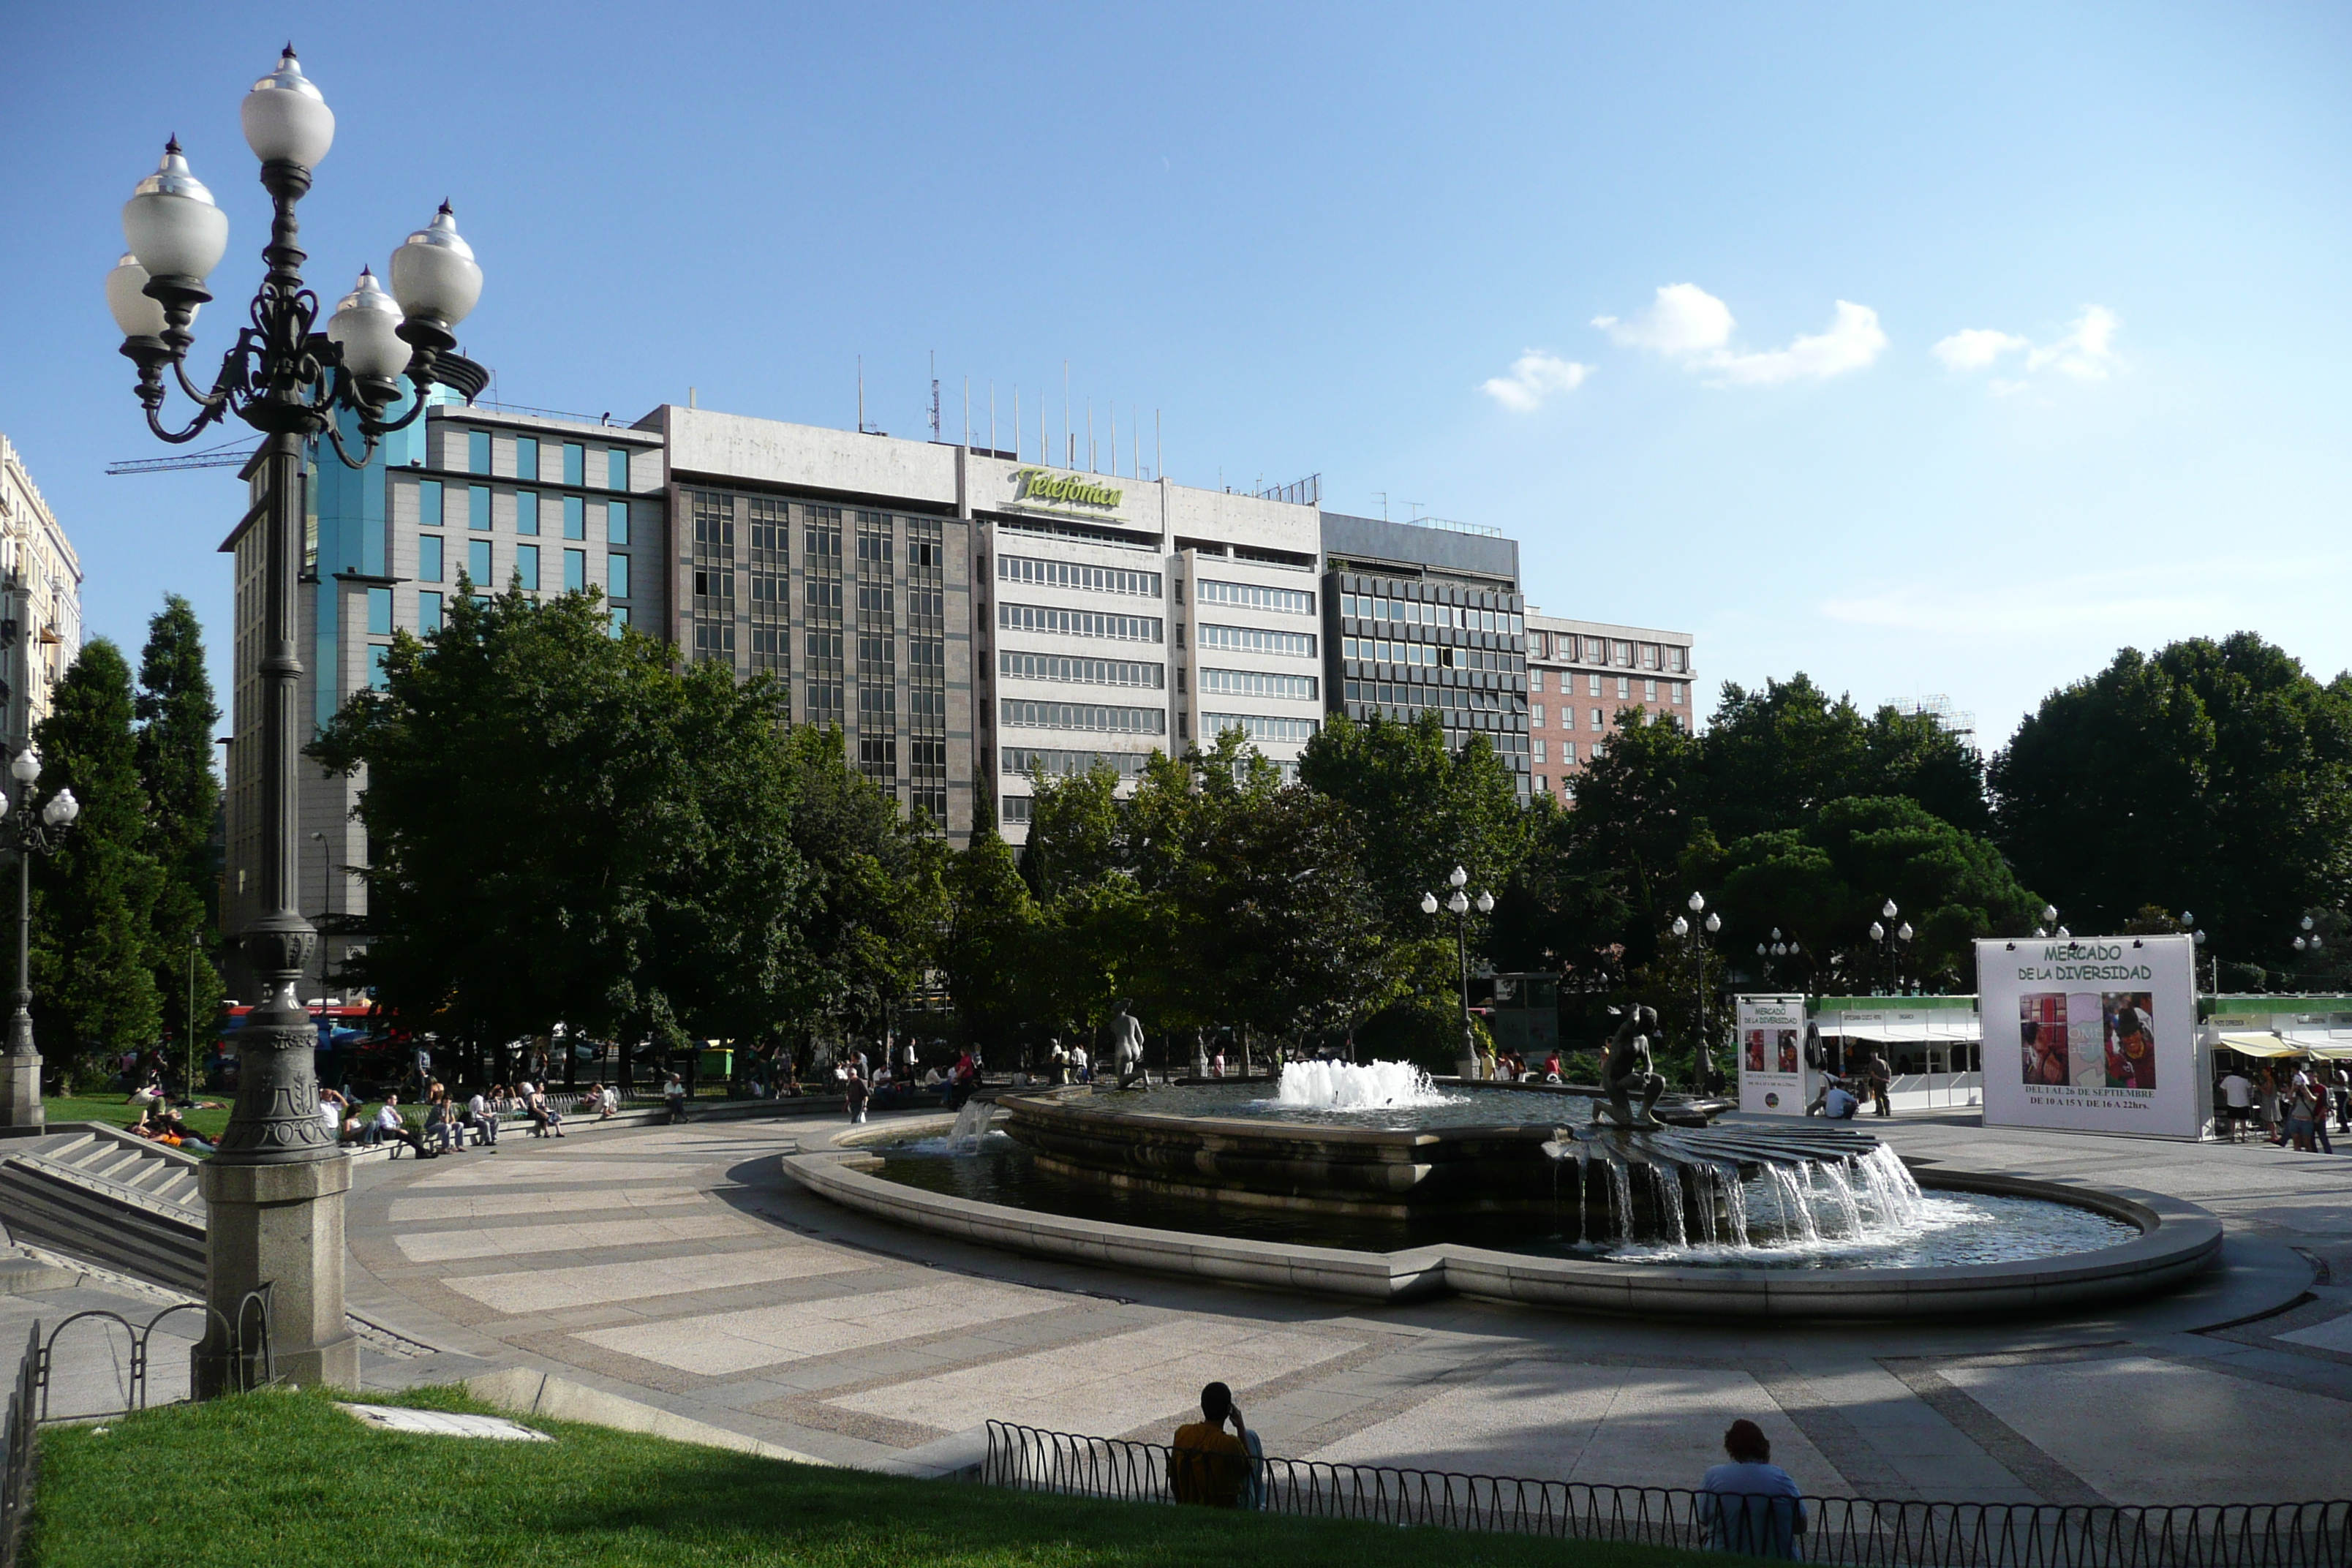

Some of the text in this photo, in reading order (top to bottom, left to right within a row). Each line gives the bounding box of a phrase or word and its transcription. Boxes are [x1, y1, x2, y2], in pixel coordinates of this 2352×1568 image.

[2044, 946, 2122, 961] MERCADO
[2019, 965, 2152, 980] DE LA DIVERSIDAD
[1755, 1007, 1786, 1015] MERCADO
[2025, 1085, 2043, 1094] DEL
[2052, 1087, 2063, 1095] AL
[2078, 1088, 2091, 1096] DE
[2092, 1088, 2155, 1098] SEPTIEMBRE
[2123, 1101, 2149, 1109] 22hrs.
